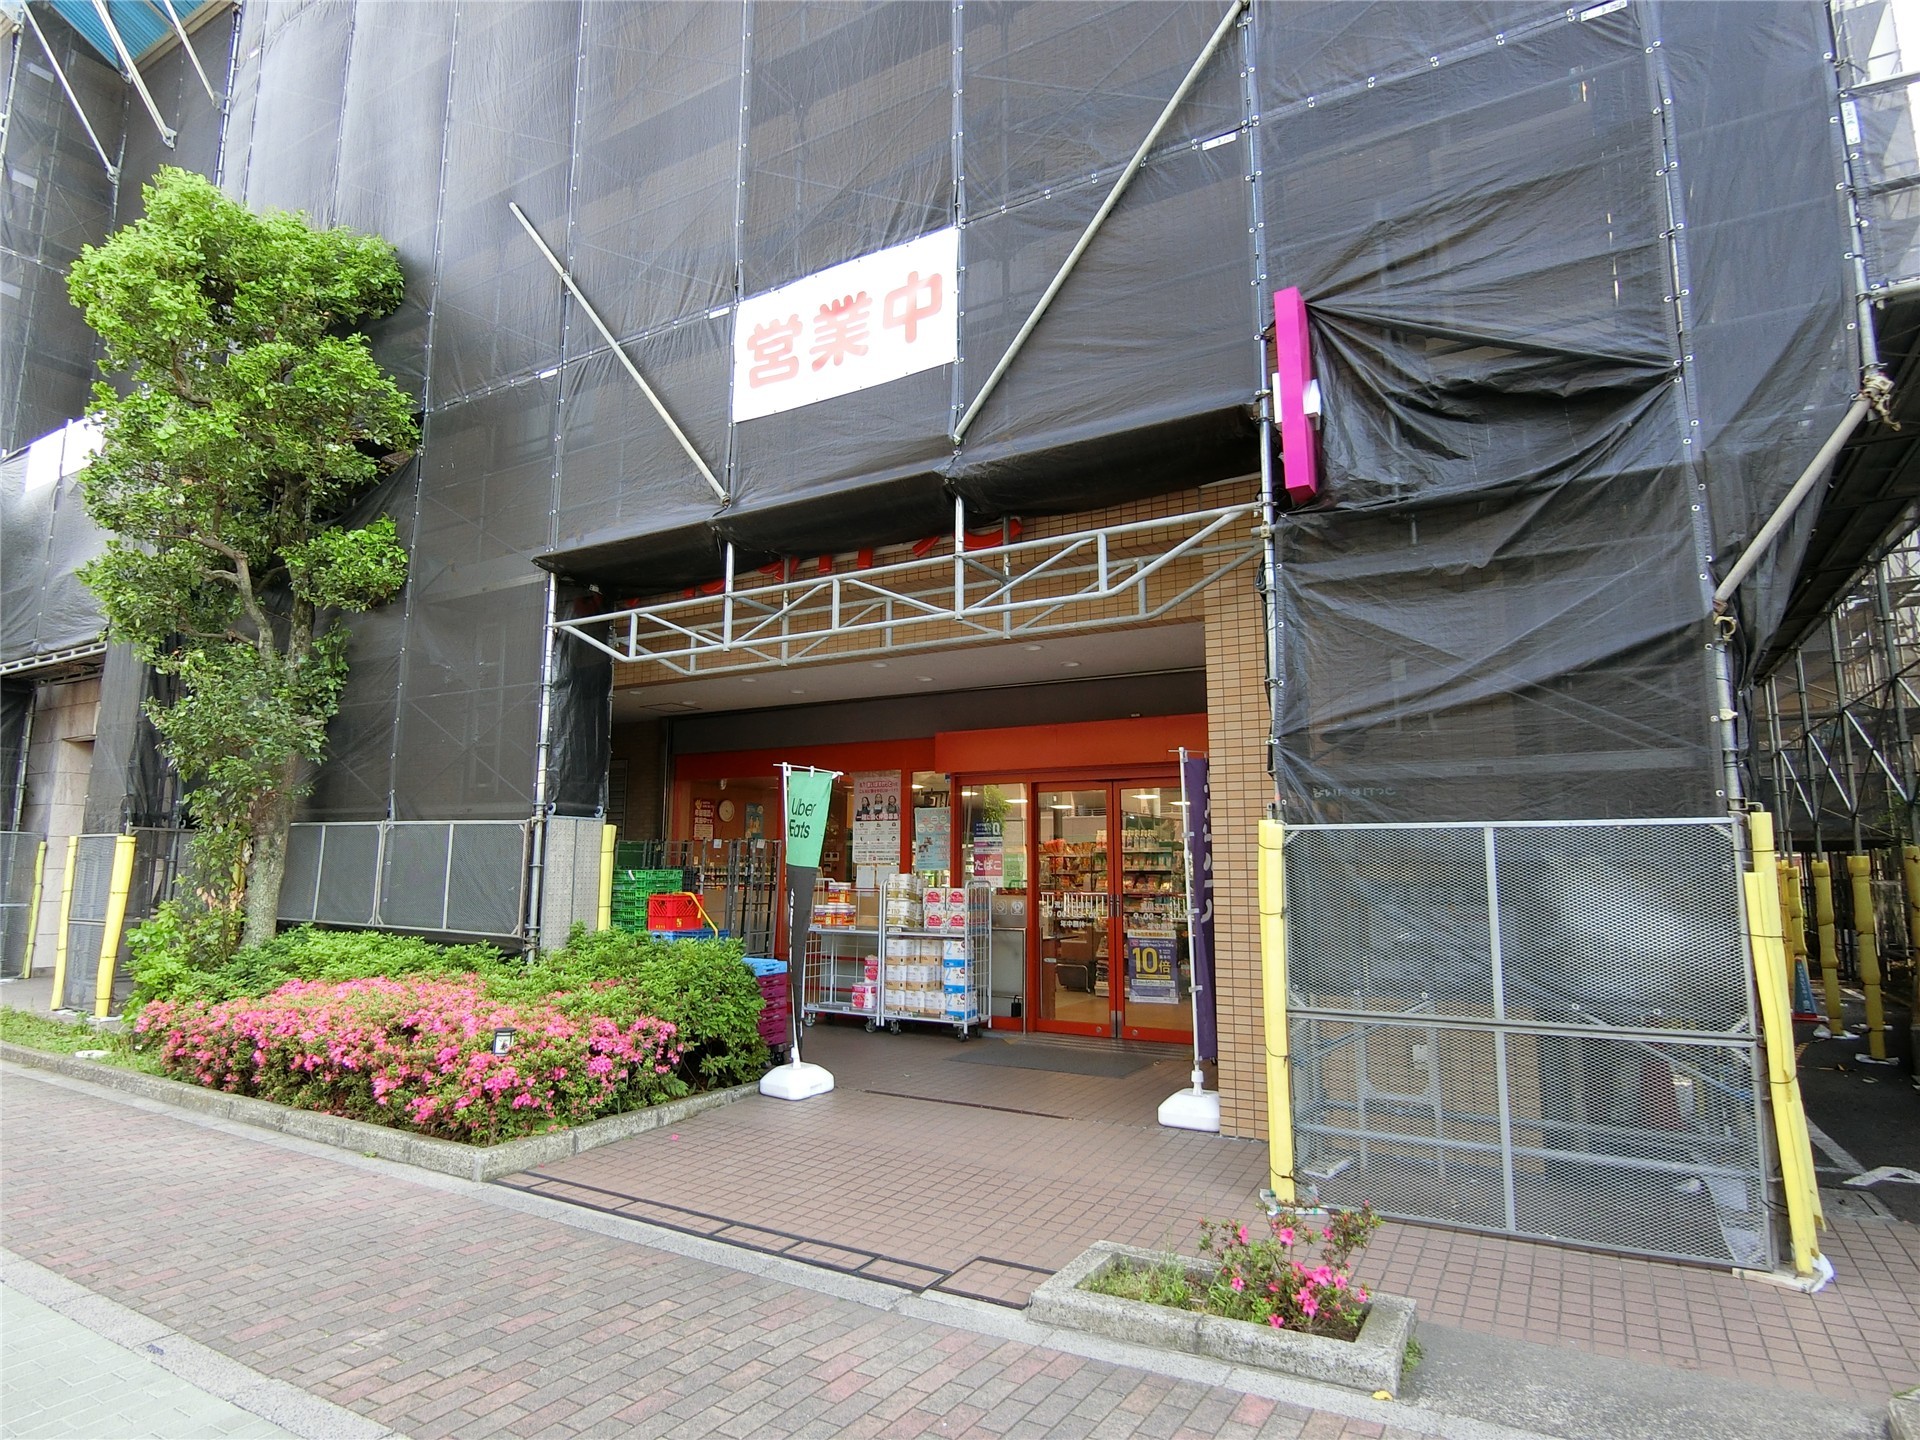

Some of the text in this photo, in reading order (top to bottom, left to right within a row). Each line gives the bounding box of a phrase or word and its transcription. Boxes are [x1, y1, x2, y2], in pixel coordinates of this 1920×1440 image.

[747, 271, 943, 389] 営業中
[791, 797, 817, 817] Uber
[789, 819, 811, 839] Eats
[974, 859, 1002, 871] たばこ
